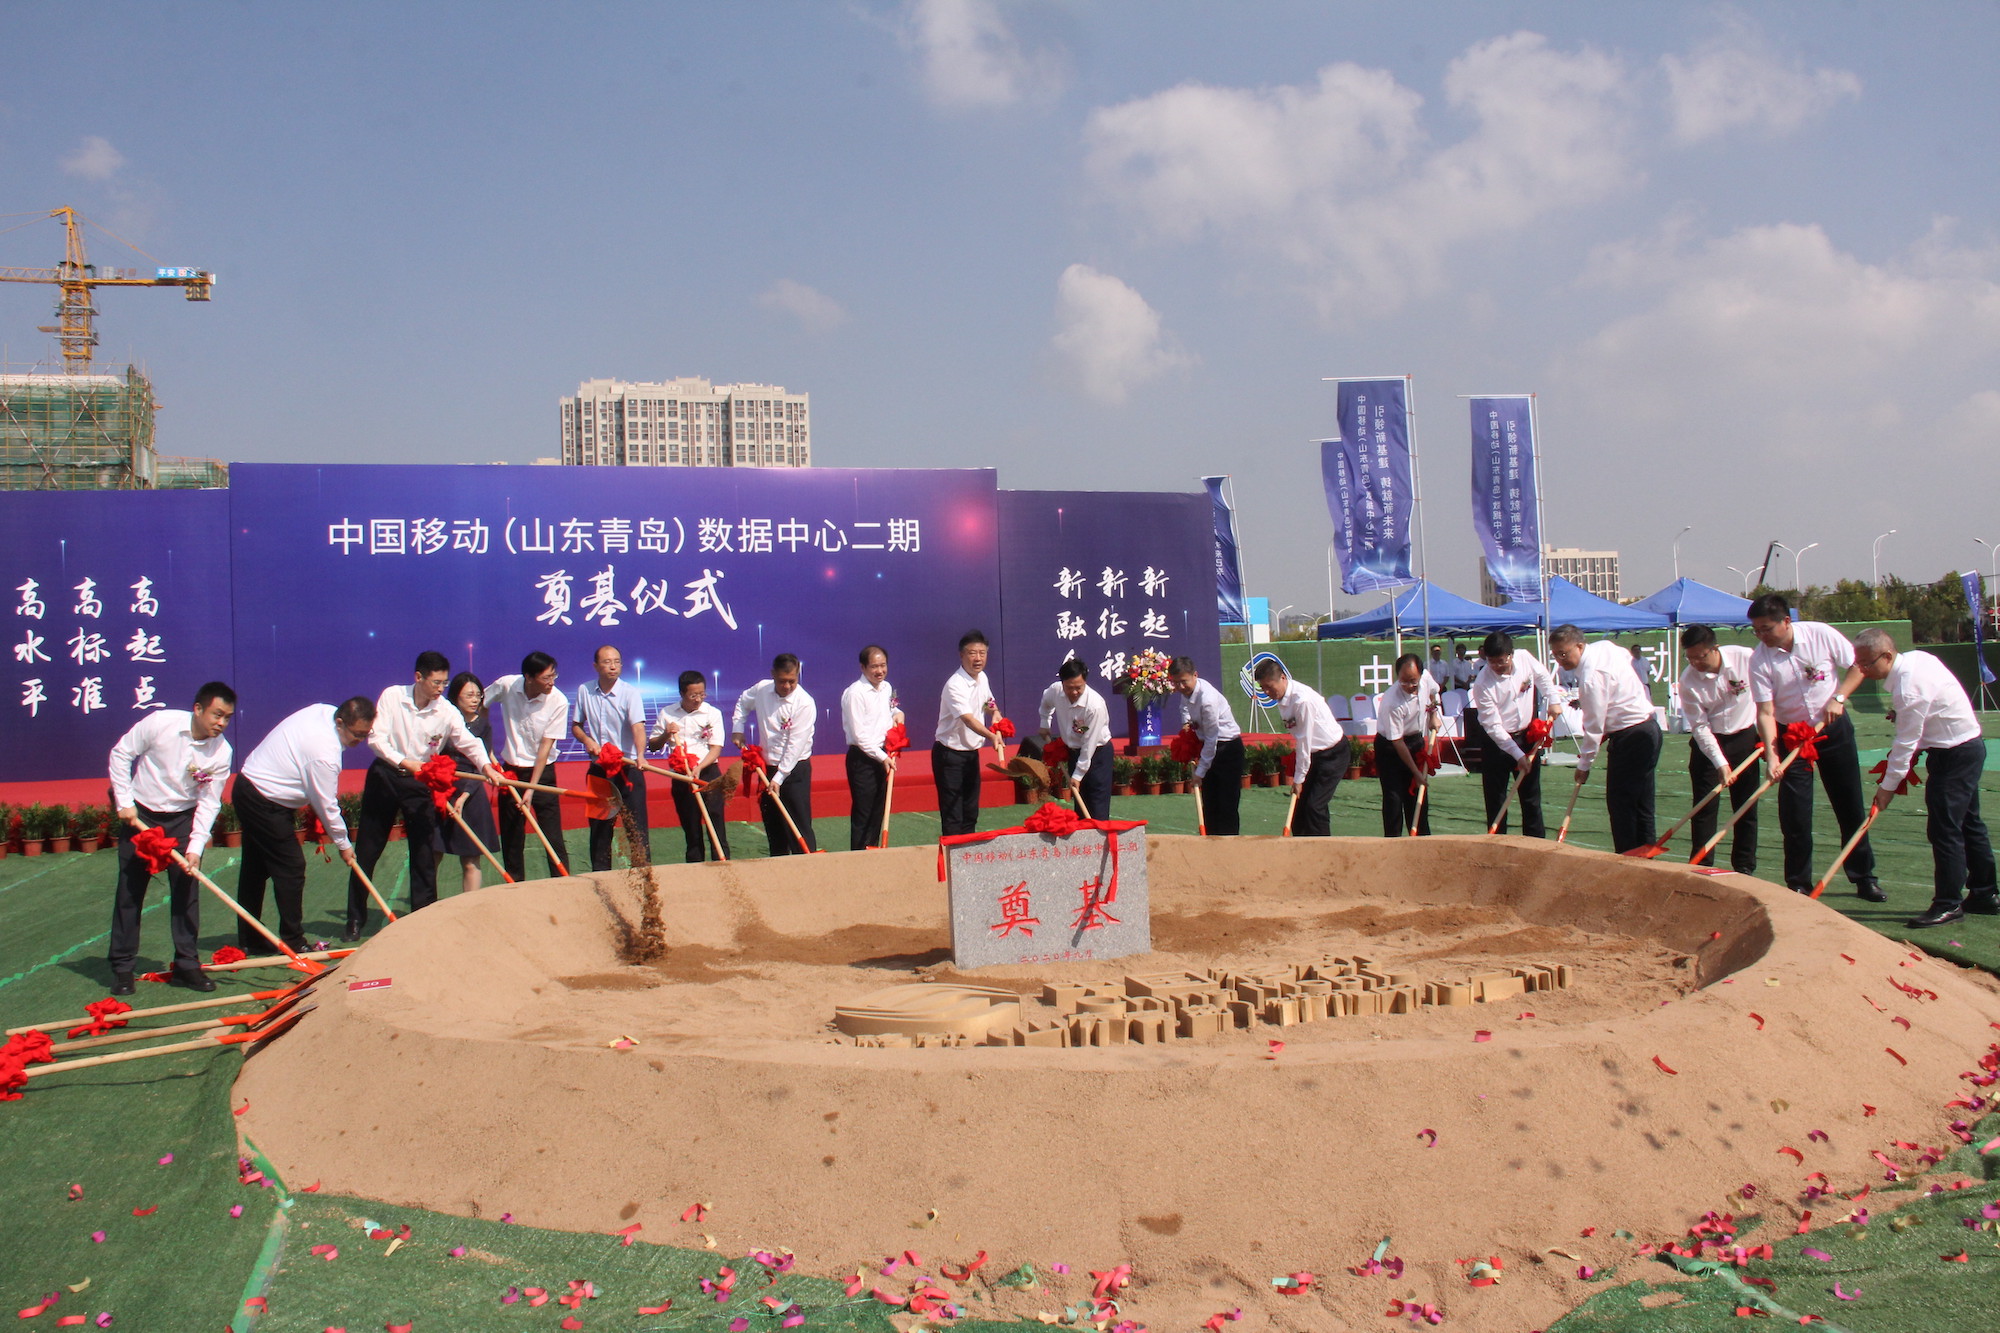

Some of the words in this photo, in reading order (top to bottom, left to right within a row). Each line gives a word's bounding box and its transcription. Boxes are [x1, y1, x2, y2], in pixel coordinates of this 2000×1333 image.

[328, 517, 921, 556] 中国移动（山东青岛）数据中心二期
[126, 575, 167, 710] 高起点
[535, 565, 738, 630] 奠基仪式
[1096, 566, 1128, 681] 新征程
[1138, 565, 1170, 657] 新起
[14, 577, 52, 718] 高水平
[67, 576, 111, 714] 高标准
[962, 841, 1138, 865] 中国移动（山东青岛）数据中二期
[990, 875, 1121, 938] 奠基
